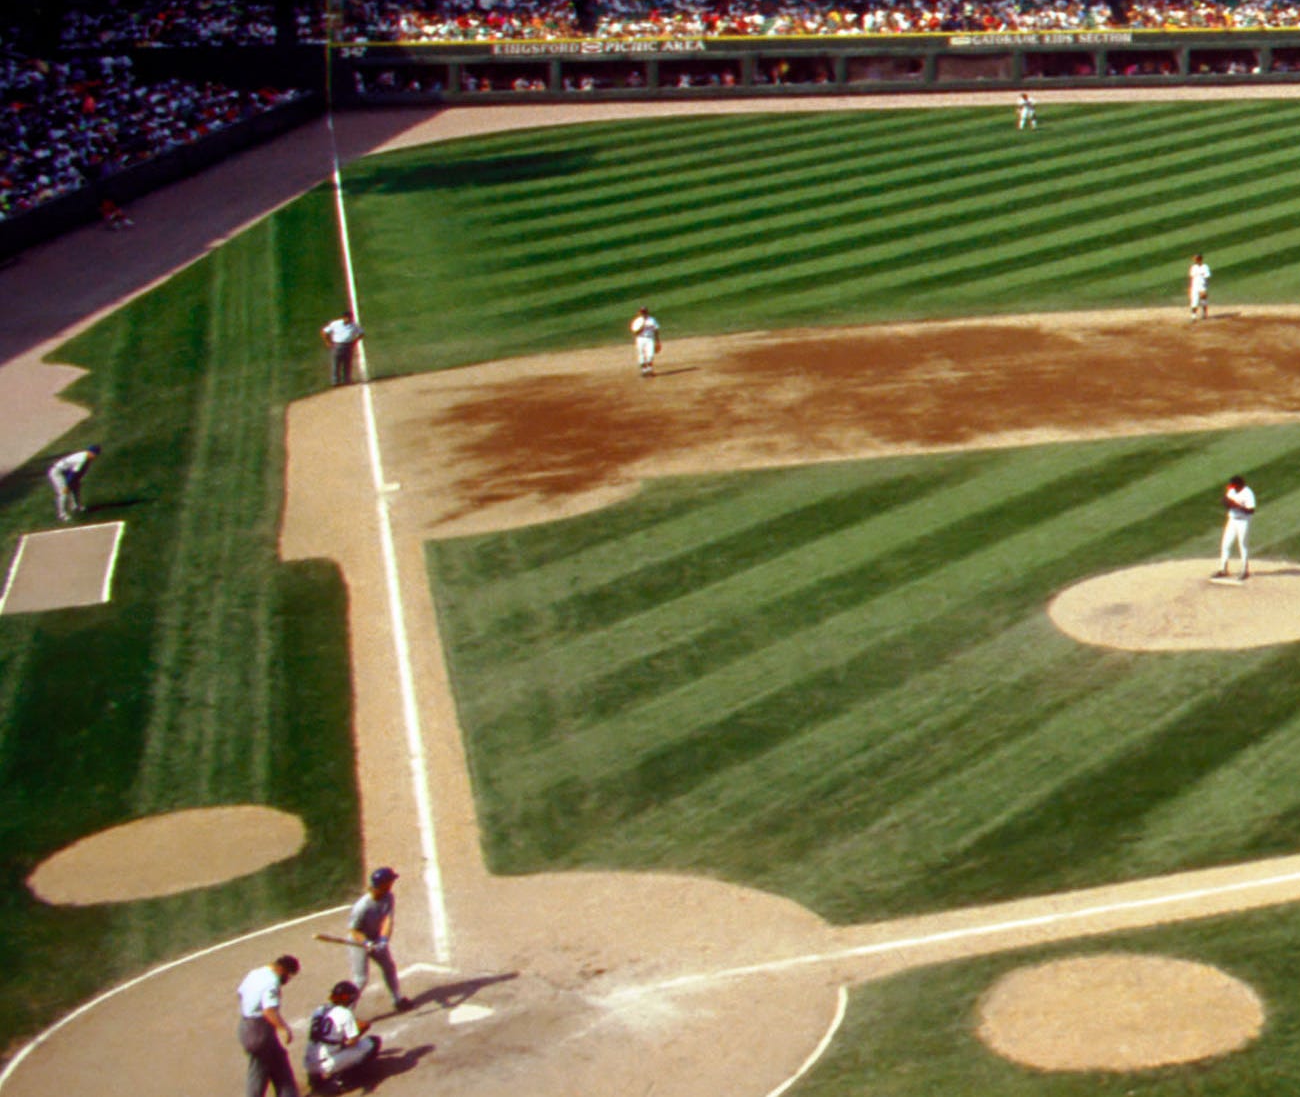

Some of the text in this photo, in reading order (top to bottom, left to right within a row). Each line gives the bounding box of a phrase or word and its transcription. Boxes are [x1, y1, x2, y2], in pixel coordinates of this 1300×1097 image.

[1078, 32, 1132, 44] SECTION
[606, 41, 658, 53] PICNIC
[662, 40, 706, 52] AREA
